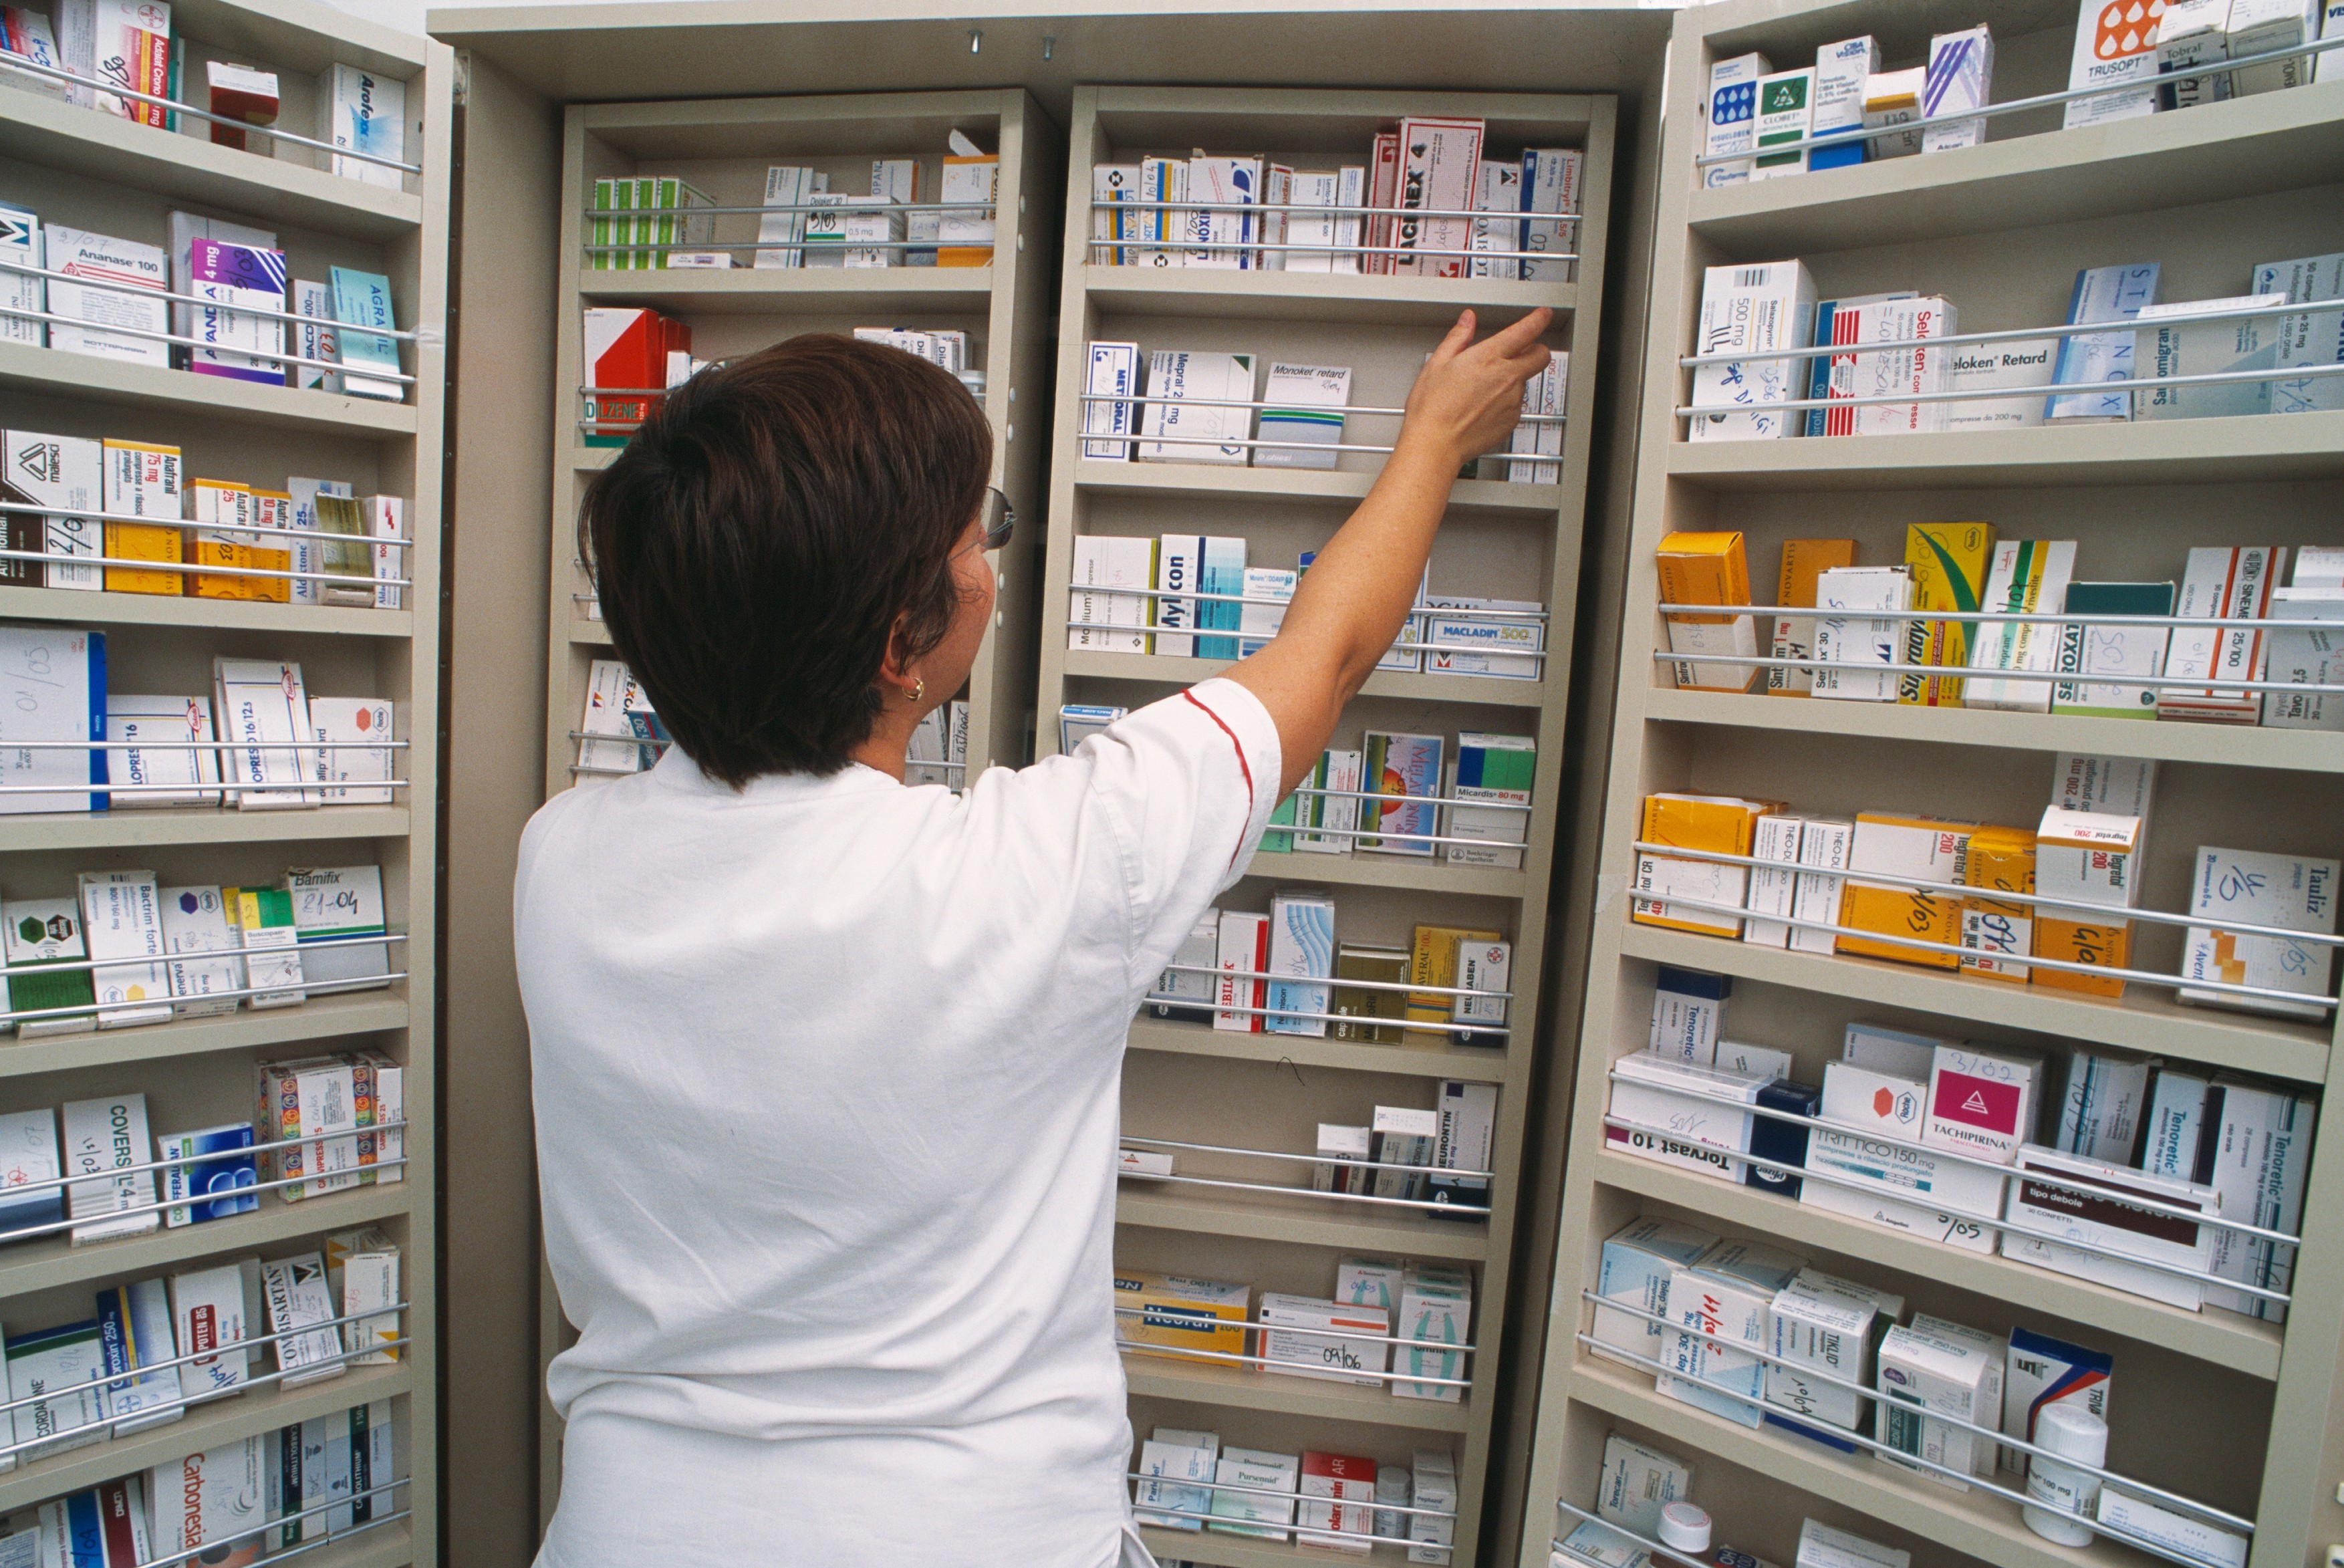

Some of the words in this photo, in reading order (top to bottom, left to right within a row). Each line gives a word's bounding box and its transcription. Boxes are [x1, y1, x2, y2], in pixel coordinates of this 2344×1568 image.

[154, 37, 165, 68] Adalat
[2166, 43, 2201, 60] Tobral
[2088, 57, 2141, 78] TRUSOPT
[153, 68, 164, 95] Crono
[1410, 142, 1428, 159] 4
[78, 249, 133, 267] Ananase
[137, 260, 159, 273] 100
[206, 246, 220, 268] mg
[205, 269, 217, 279] 4
[369, 284, 389, 354] AGRAIL
[1735, 298, 1750, 321] 500
[205, 285, 217, 360] AVANDA
[1731, 325, 1744, 346] mg
[2101, 269, 2151, 409] STINOX
[1174, 353, 1189, 386] Mepral
[2002, 350, 2047, 367] Retard
[1273, 365, 1314, 376] Monoket
[1316, 369, 1346, 380] retard
[585, 402, 640, 420] DILZENE
[1112, 369, 1126, 434] METORAL
[1168, 408, 1180, 425] mg
[47, 443, 60, 483] malesci
[147, 453, 161, 466] 75
[145, 468, 158, 483] mg
[164, 455, 178, 495] Anafranil
[222, 489, 235, 503] 25
[263, 498, 275, 509] 10
[261, 510, 273, 524] mg
[297, 510, 307, 526] 25
[297, 545, 307, 598] Aldctone
[1783, 542, 1796, 598] NOVARTIS
[1160, 555, 1184, 629] Mylcon
[1444, 626, 1498, 638] MACLADIN
[1501, 627, 1530, 641] 500
[1819, 632, 1829, 646] 30
[2227, 631, 2244, 667] 25/100
[1816, 650, 1827, 689] Serax
[126, 723, 138, 737] 16
[1457, 787, 1493, 797] Micardis
[1497, 791, 1509, 799] 80
[1511, 793, 1525, 801] mg
[1466, 850, 1499, 859] Boehringer
[1939, 833, 1954, 854] 200
[1465, 856, 1494, 864] Ingelheim
[2092, 852, 2107, 870] 200
[2107, 854, 2127, 887] Tegretol
[295, 872, 342, 886] Bamifix
[2306, 866, 2329, 914] Tauliz
[109, 886, 120, 916] 800/160
[140, 885, 153, 926] Bactrim
[111, 918, 120, 930] mg
[145, 930, 158, 955] forte
[178, 962, 187, 999] enerva
[1463, 959, 1476, 1015] NEUABEN
[1277, 987, 1287, 1025] Nomison
[1683, 1005, 1700, 1057] Tenoretic
[1900, 1095, 1912, 1120] Roche
[1438, 1110, 1452, 1171] EURONTIN
[1632, 1132, 1655, 1150] 10
[1816, 1128, 1891, 1157] TRITTICO
[1892, 1148, 1918, 1165] 150
[1918, 1158, 1936, 1170] mg
[1933, 1124, 2008, 1151] TACHIPIRINA
[2164, 1110, 2188, 1171] Tenoretic
[110, 1104, 132, 1186] COVERSL
[124, 1188, 136, 1198] 4
[1660, 1140, 1732, 1171] Torvast
[1815, 1144, 1855, 1160] compresse
[1861, 1153, 1891, 1168] rilascio
[1892, 1162, 1934, 1178] prolungato
[2269, 1136, 2291, 1202] Tenoretic
[2029, 1187, 2048, 1200] tipo
[2049, 1192, 2083, 1208] debole
[1885, 1218, 1910, 1228] Angelini
[2037, 1210, 2073, 1224] CONFETTI
[104, 1321, 118, 1343] 250
[197, 1319, 209, 1364] CPOTEN
[1892, 1325, 1930, 1343] Tudcabil
[1932, 1338, 1951, 1349] 250
[1952, 1345, 1968, 1356] mg
[1825, 1334, 1841, 1365] TIKLID
[31, 1378, 51, 1438] CORDANE
[1238, 1471, 1277, 1484] Pursennid
[1332, 1458, 1345, 1476] AR
[1609, 1474, 1623, 1509] Torecan
[2042, 1478, 2057, 1489] 100
[2057, 1484, 2071, 1496] mg
[183, 1452, 205, 1551] Carbonesia
[1328, 1480, 1344, 1533] olaramin
